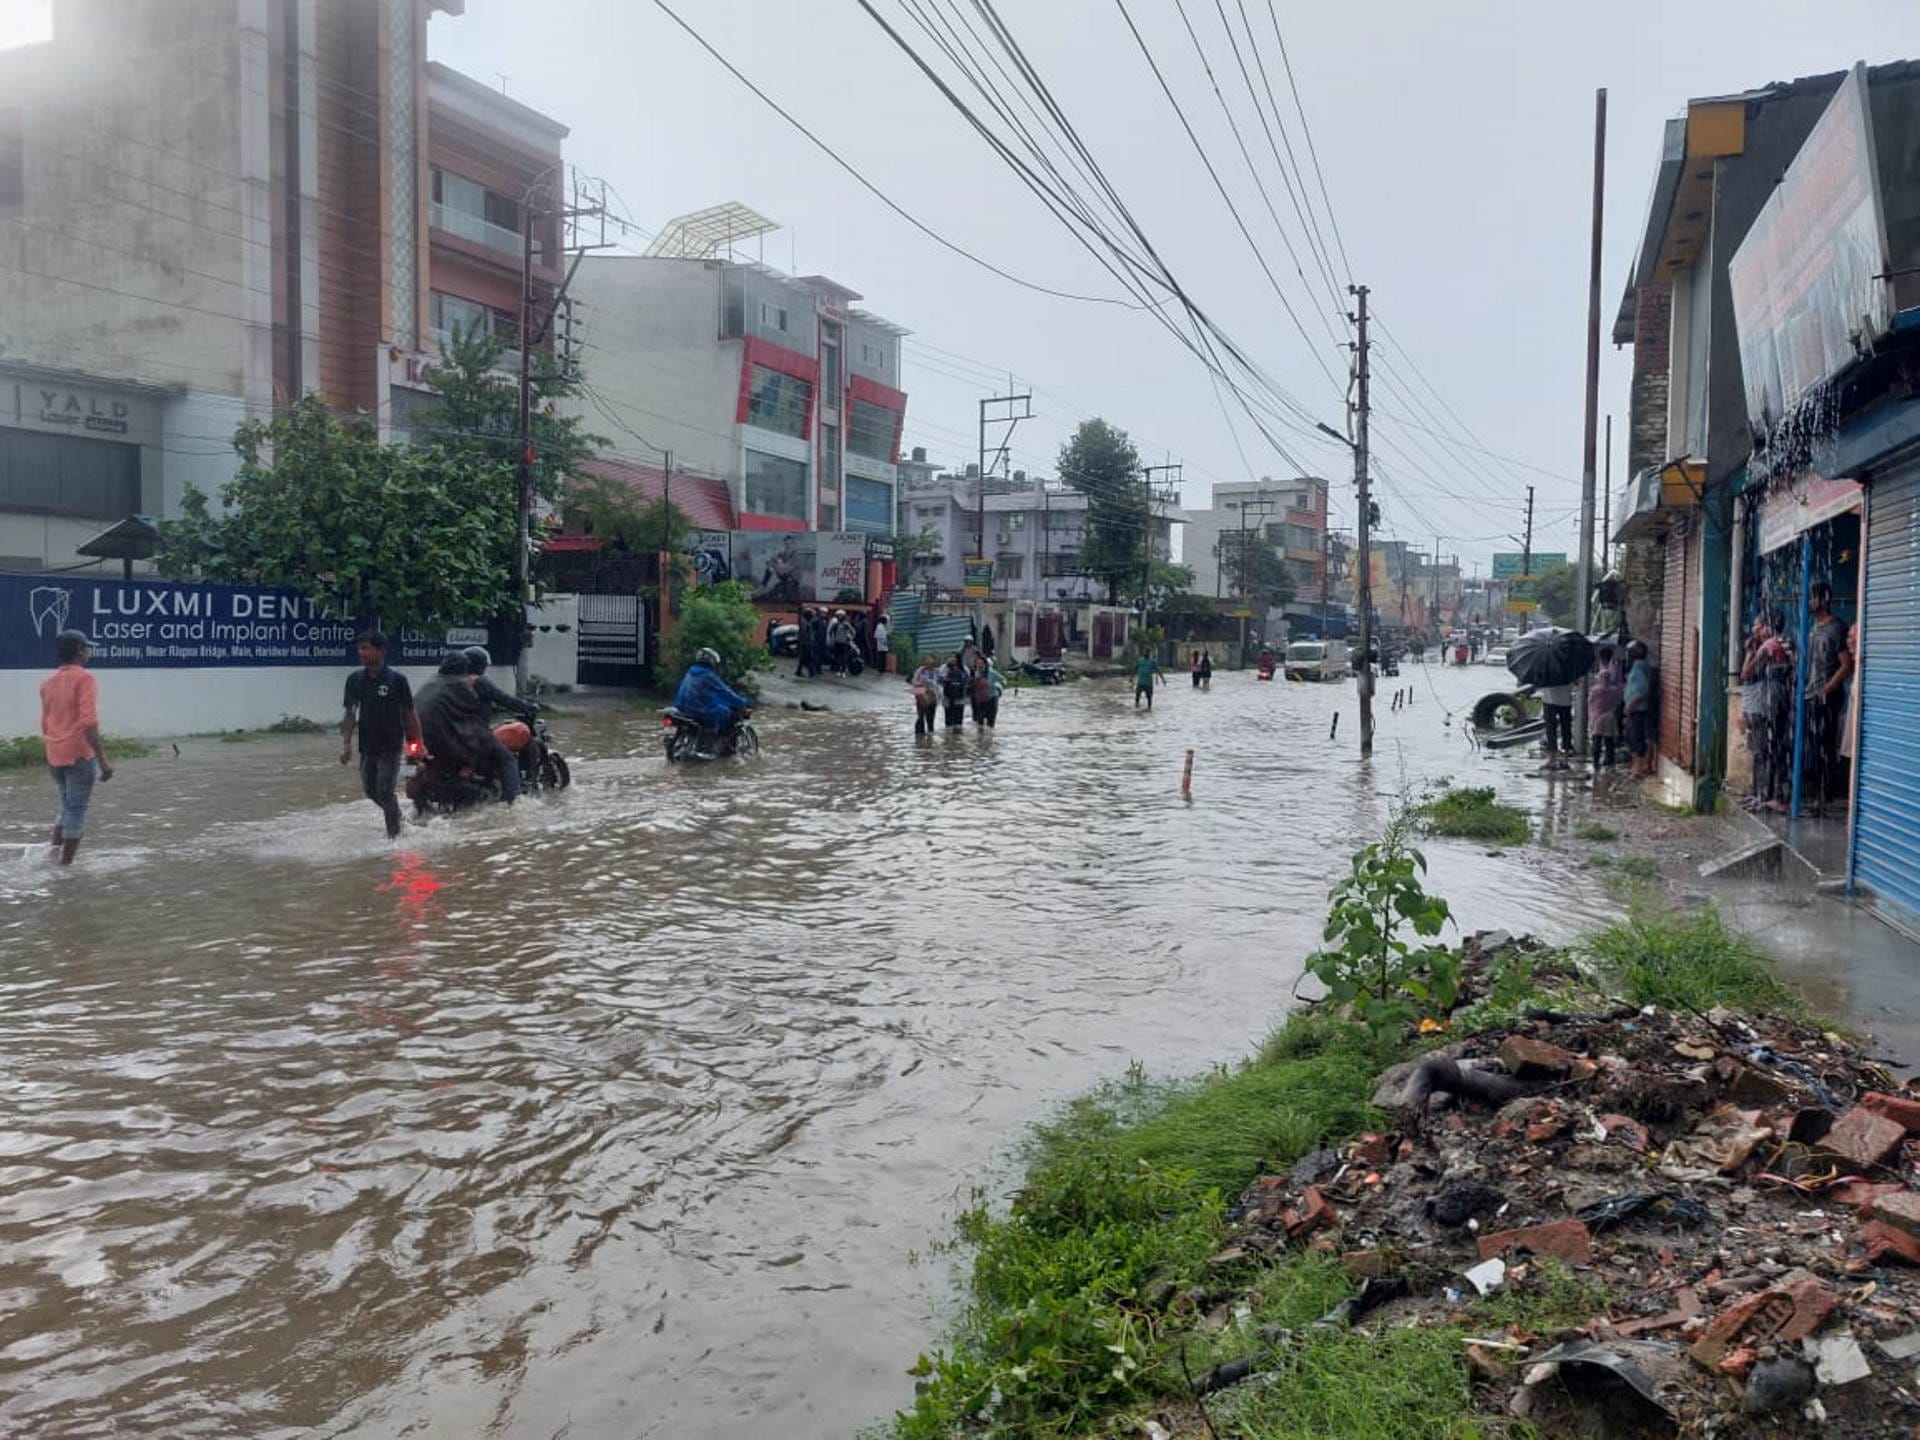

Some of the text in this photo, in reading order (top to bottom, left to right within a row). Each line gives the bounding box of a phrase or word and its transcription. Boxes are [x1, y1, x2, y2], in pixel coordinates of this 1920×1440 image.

[93, 588, 357, 621] LUXMI DENTAL
[92, 618, 355, 644] Laser and Implant Centre
